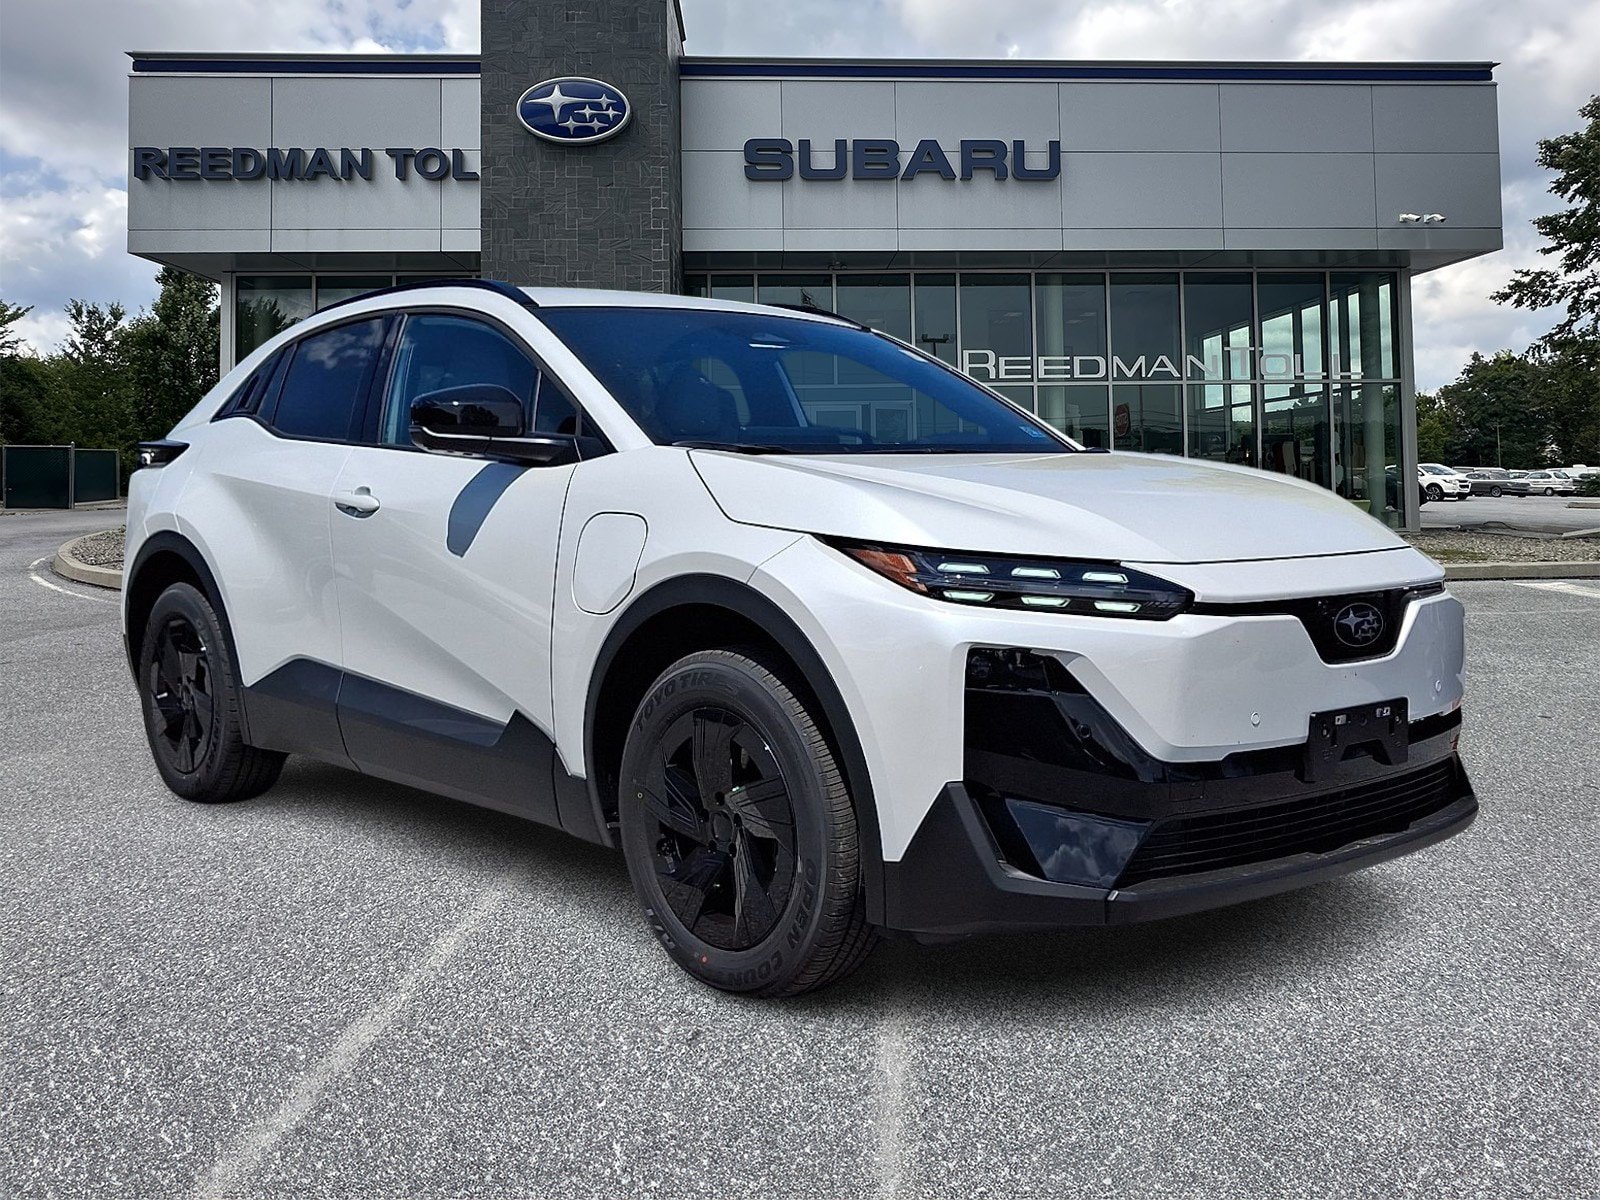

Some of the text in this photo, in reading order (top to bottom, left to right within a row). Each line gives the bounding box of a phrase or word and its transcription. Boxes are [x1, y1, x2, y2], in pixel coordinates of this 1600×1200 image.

[134, 147, 372, 181] REEDMAN
[744, 138, 1061, 181] SUBARU
[962, 346, 1364, 380] REEDMAN TOLL
